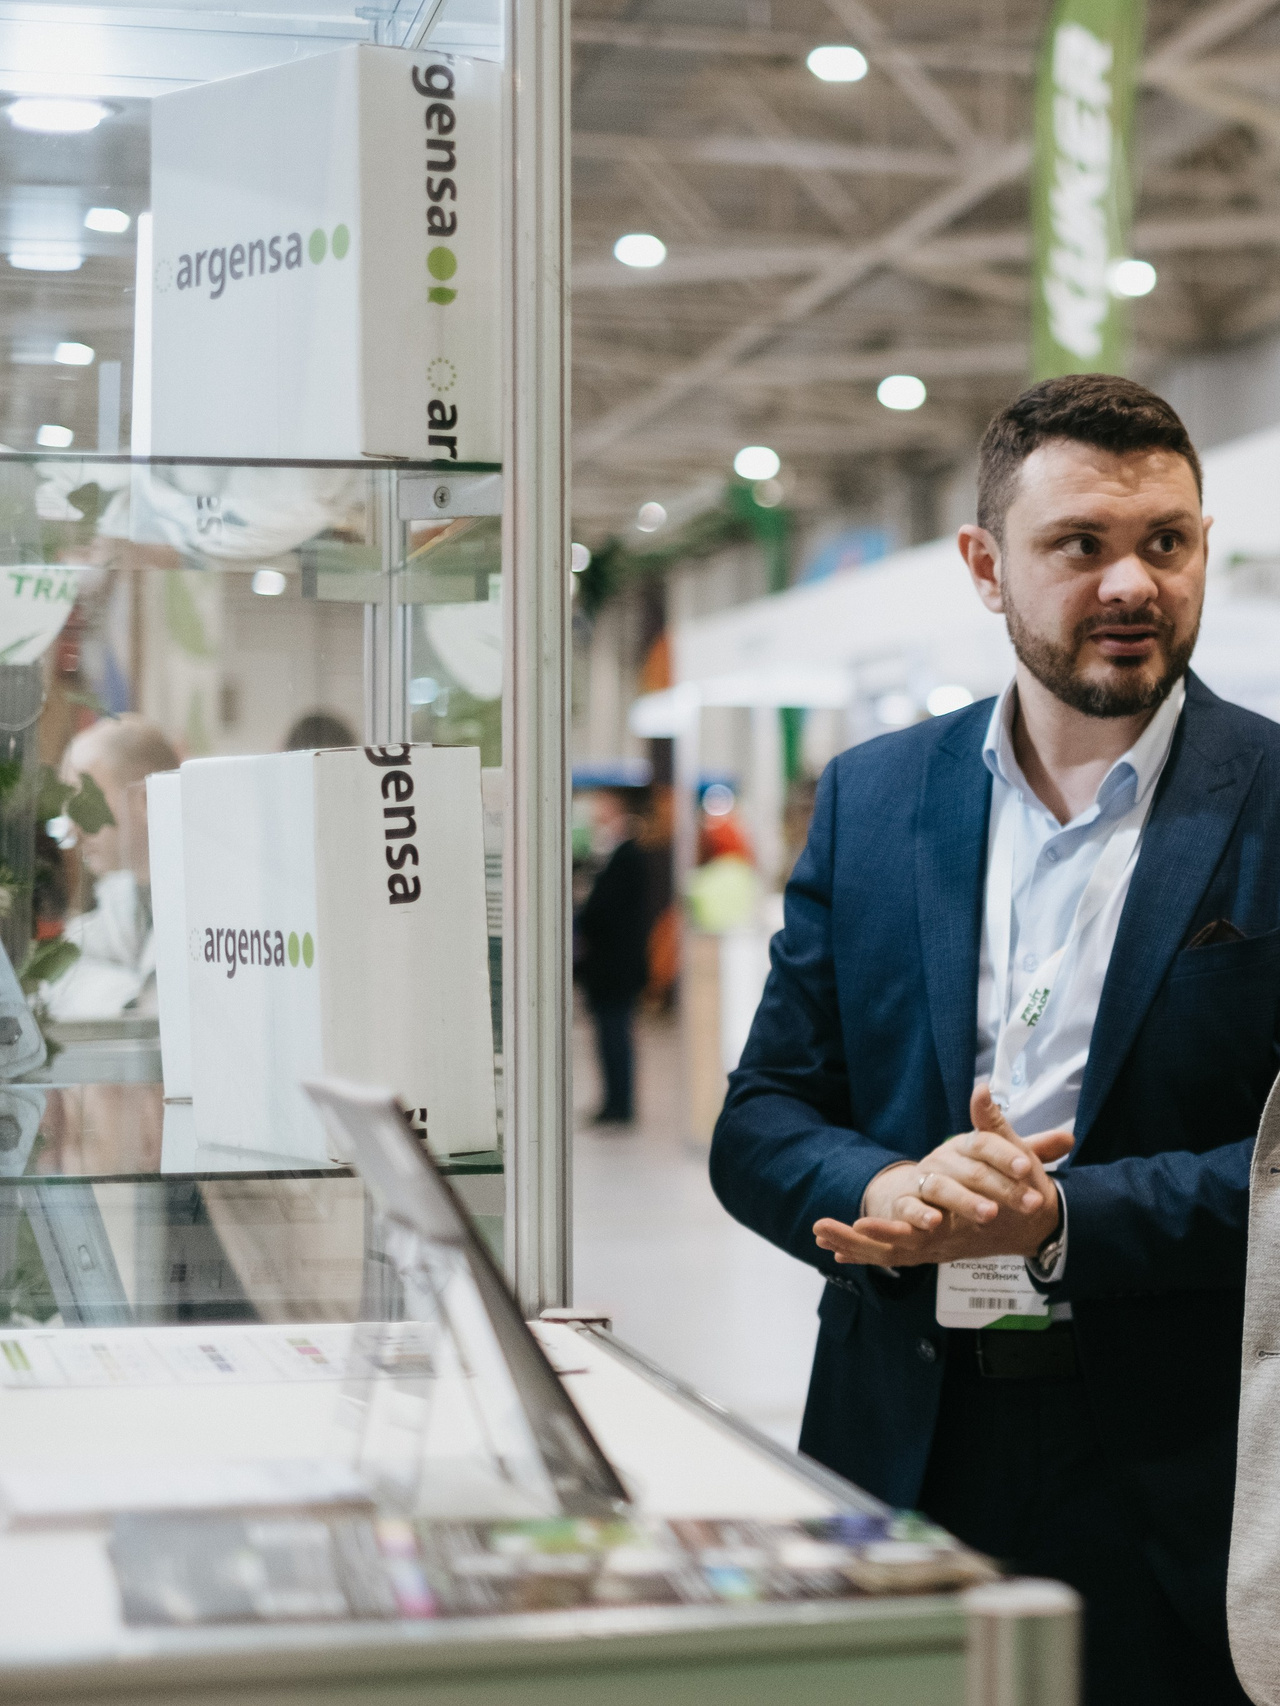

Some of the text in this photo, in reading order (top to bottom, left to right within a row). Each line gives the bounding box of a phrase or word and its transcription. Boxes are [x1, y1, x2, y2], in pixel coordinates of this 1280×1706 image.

[411, 54, 458, 238] gensa
[176, 232, 303, 300] argensa
[427, 399, 458, 463] ar
[204, 927, 285, 979] argensa
[950, 1262, 999, 1271] АЛЕКСАНДР
[972, 1271, 1019, 1281] ОЛЕЙНИК
